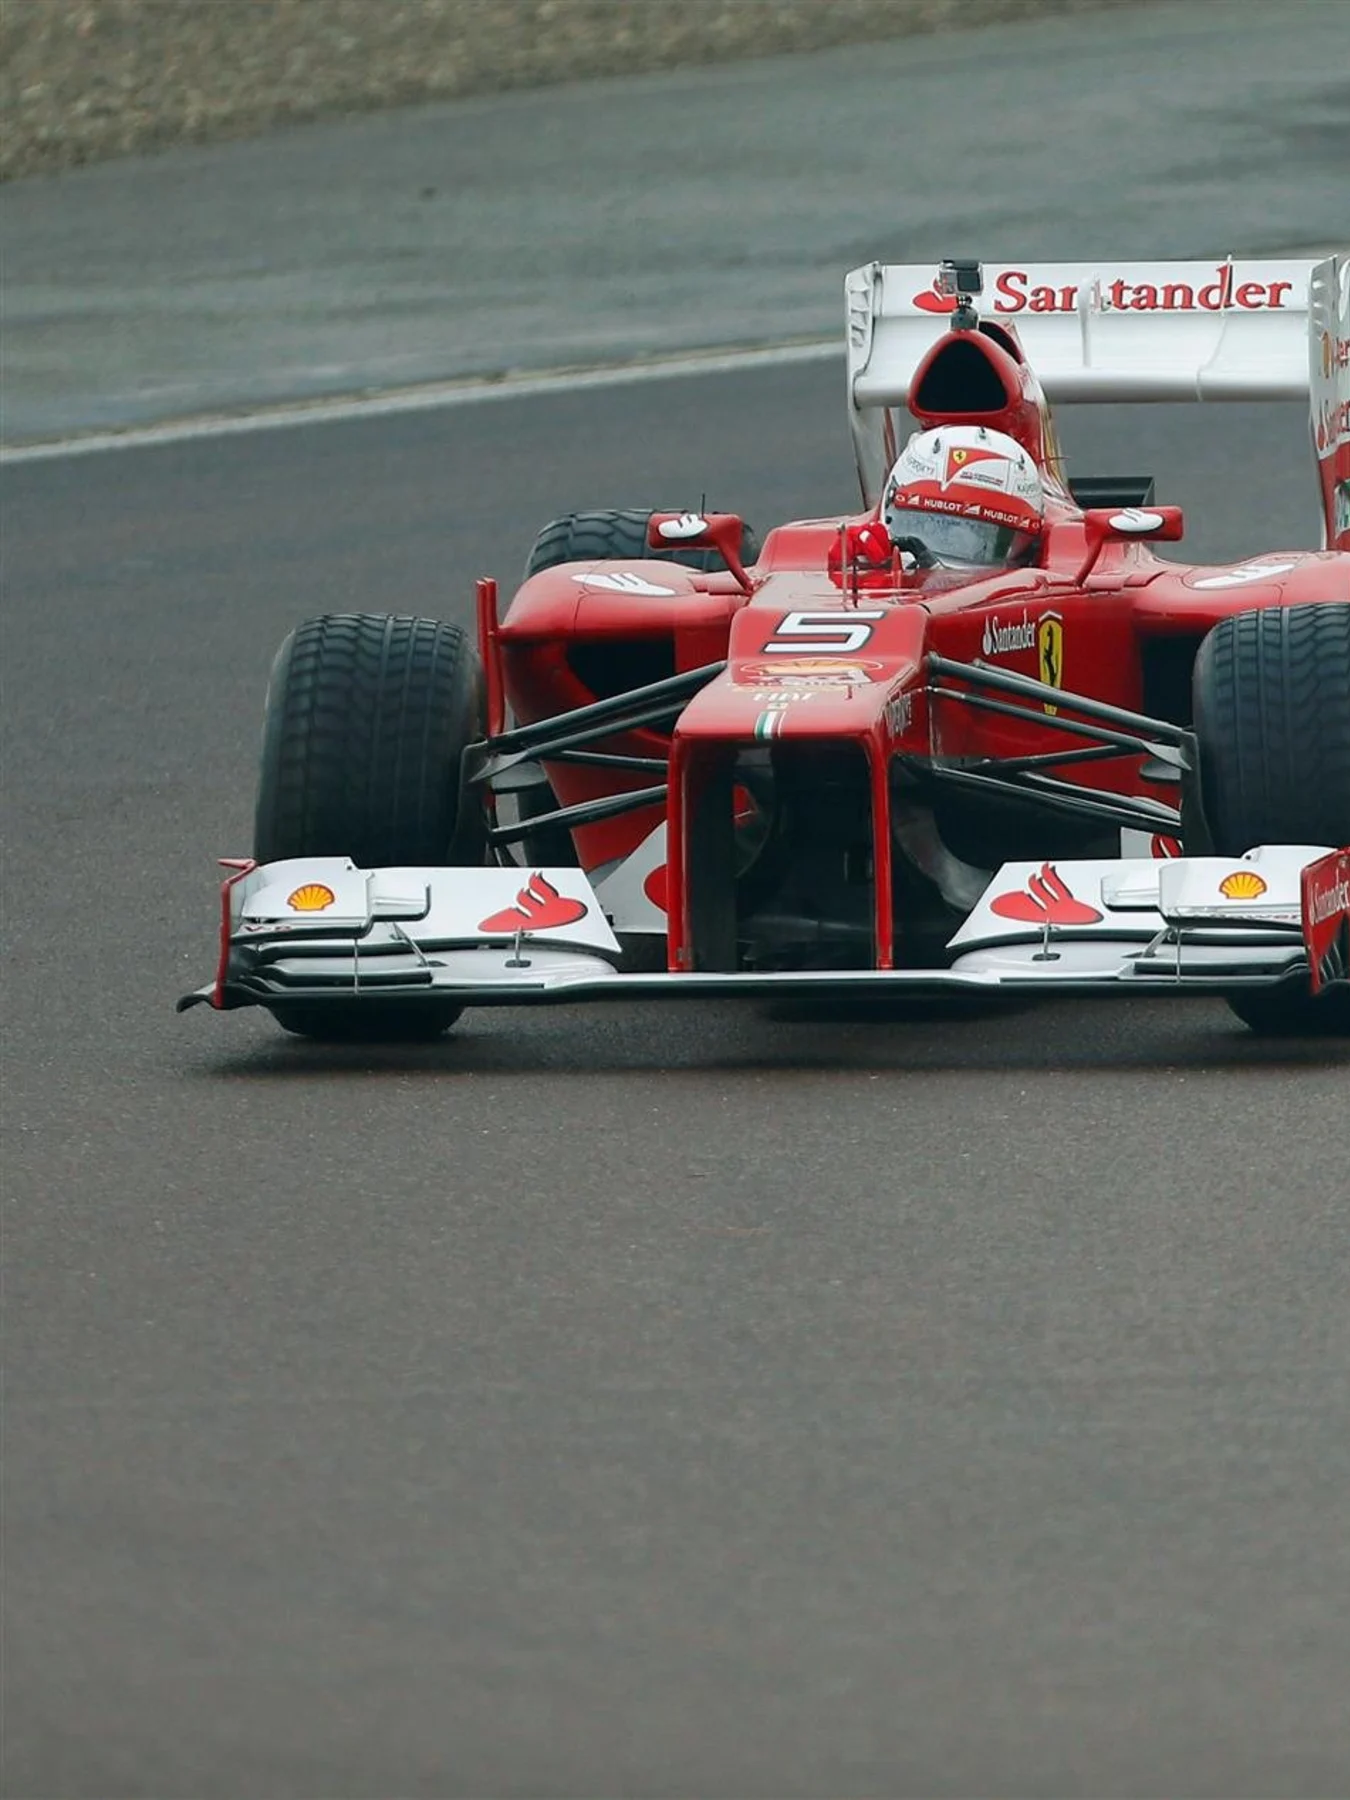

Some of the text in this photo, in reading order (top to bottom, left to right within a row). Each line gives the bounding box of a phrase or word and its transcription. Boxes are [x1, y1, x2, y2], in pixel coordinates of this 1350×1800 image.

[923, 499, 962, 512] HUBLOT
[983, 508, 1019, 523] HUBLOT
[761, 610, 887, 655] 5
[992, 608, 1035, 654] Santander
